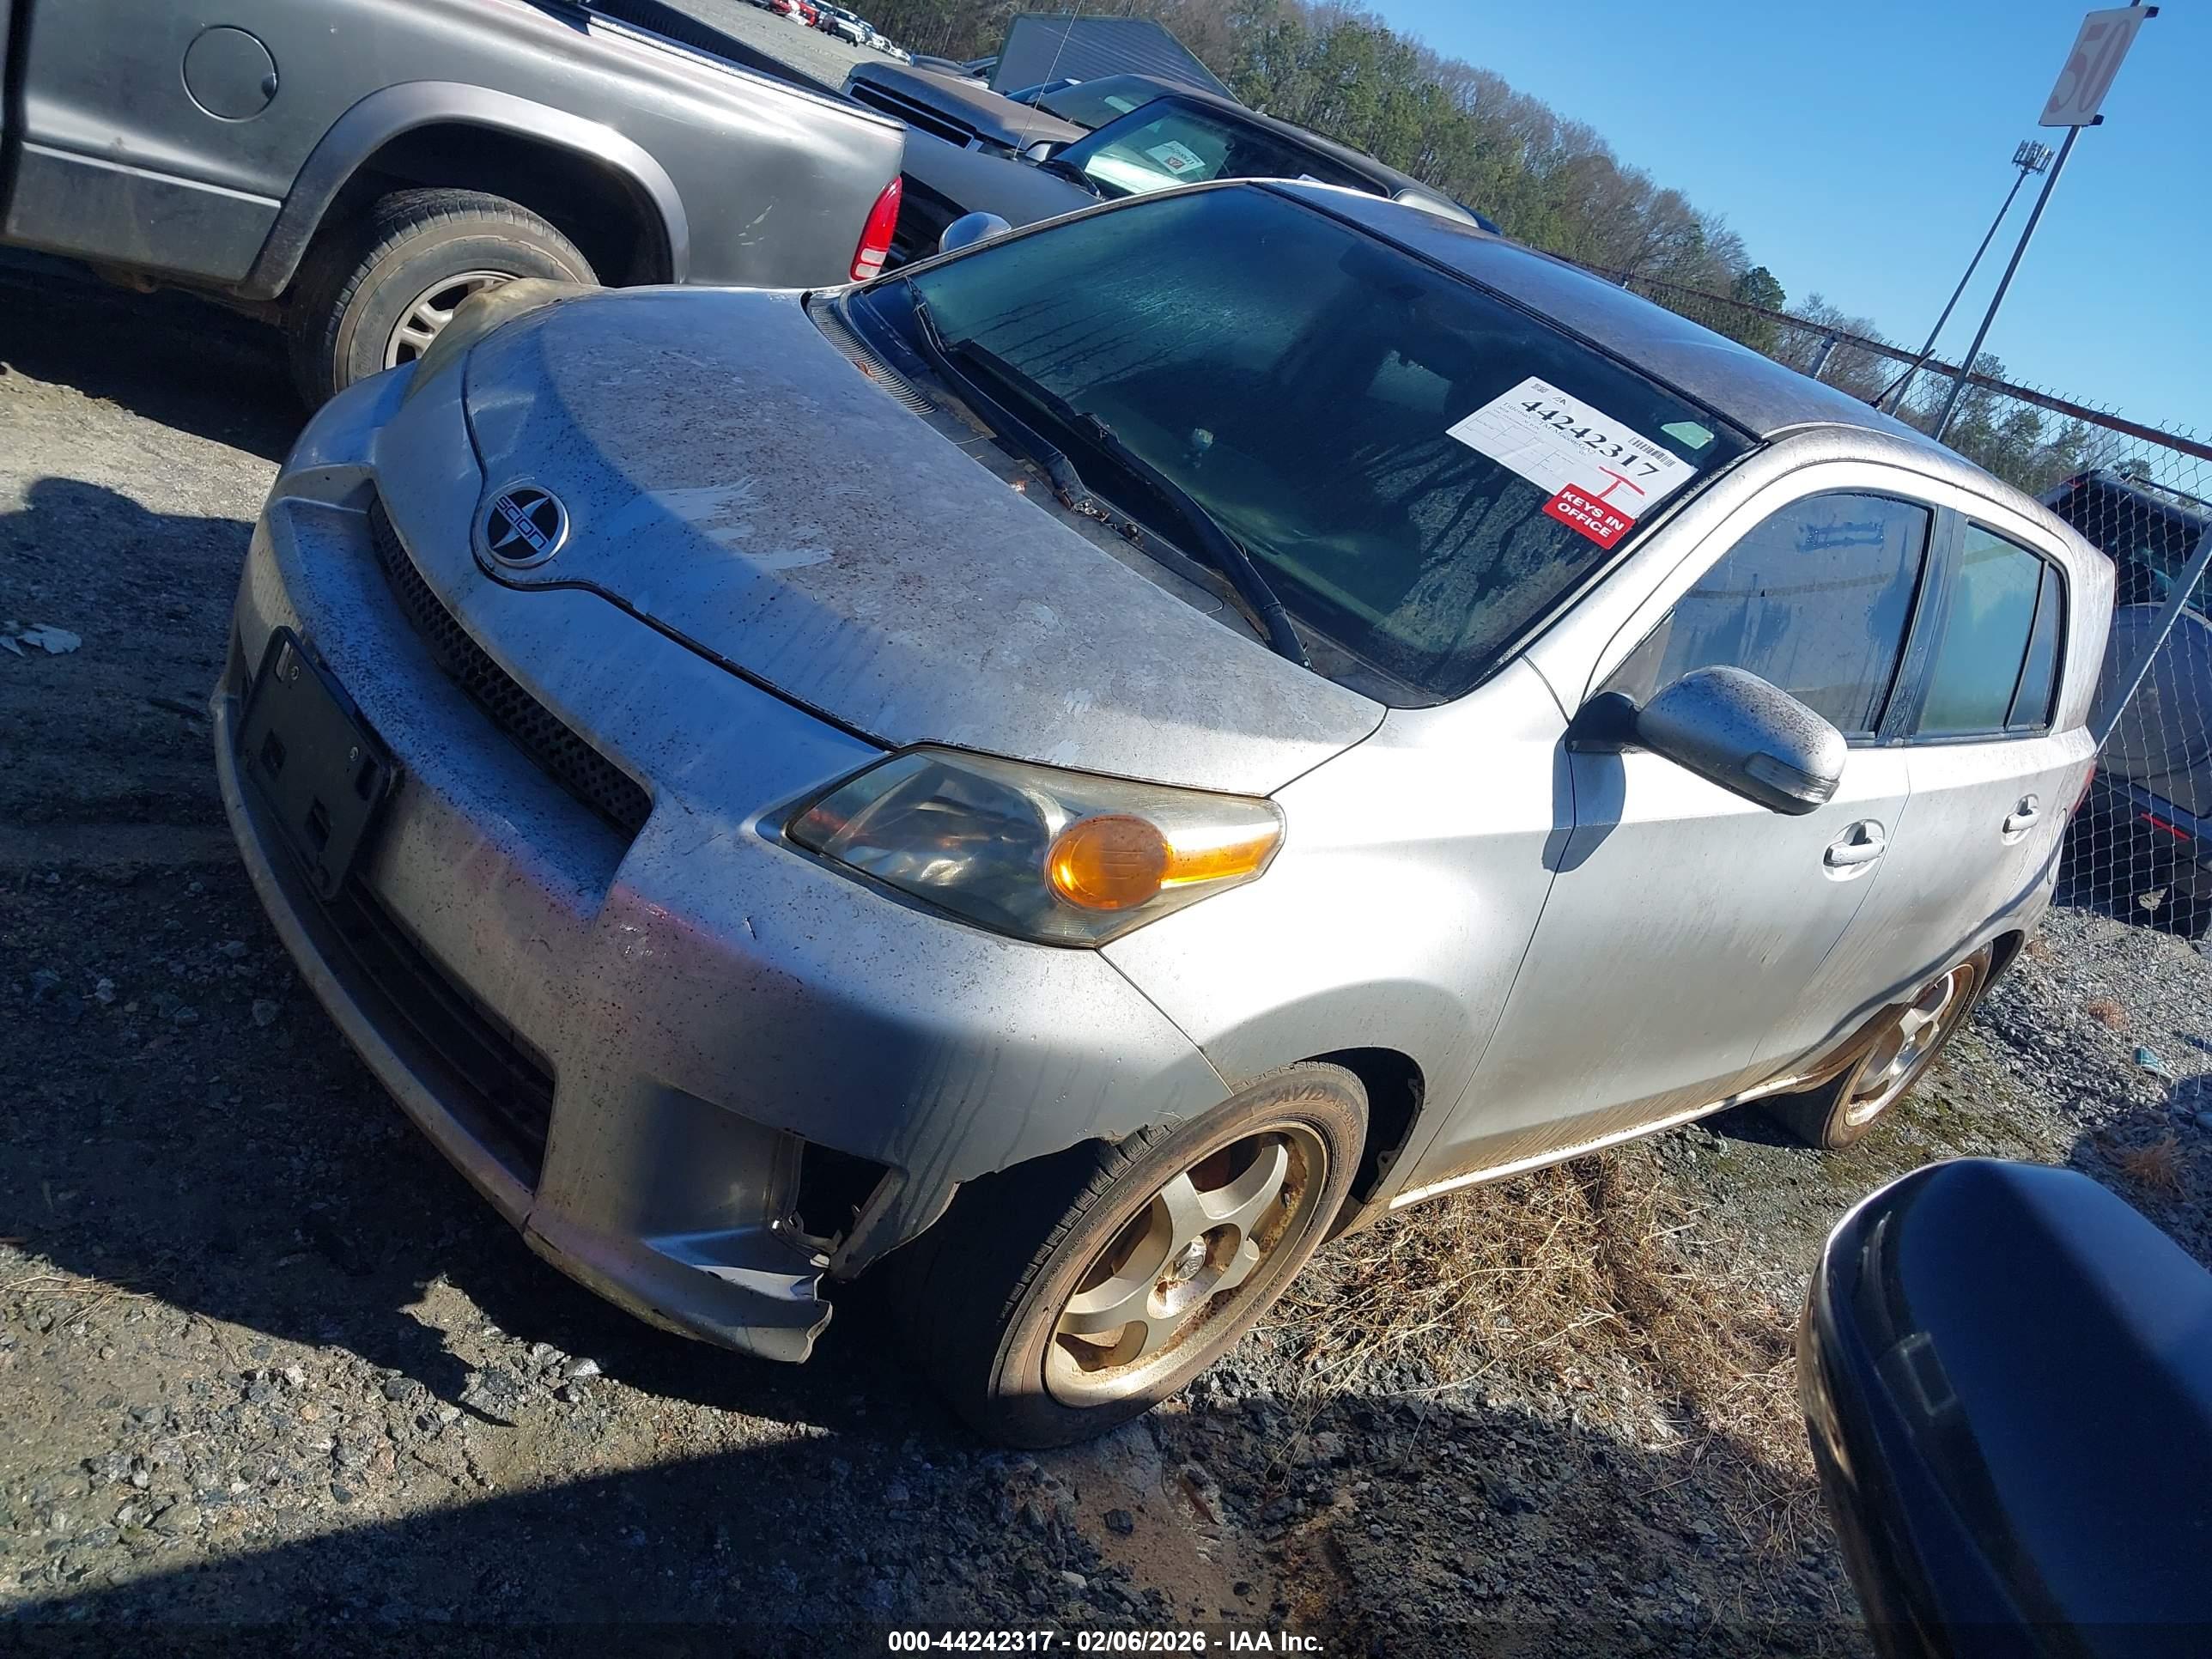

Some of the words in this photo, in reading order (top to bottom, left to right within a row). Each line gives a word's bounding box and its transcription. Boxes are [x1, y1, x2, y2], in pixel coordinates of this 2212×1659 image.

[2048, 19, 2130, 113] 50
[1521, 400, 1661, 477] 44242317
[495, 495, 549, 550] SCION
[1558, 502, 1612, 538] OFFICE
[1562, 491, 1604, 518] KEYS
[1604, 516, 1625, 532] IN
